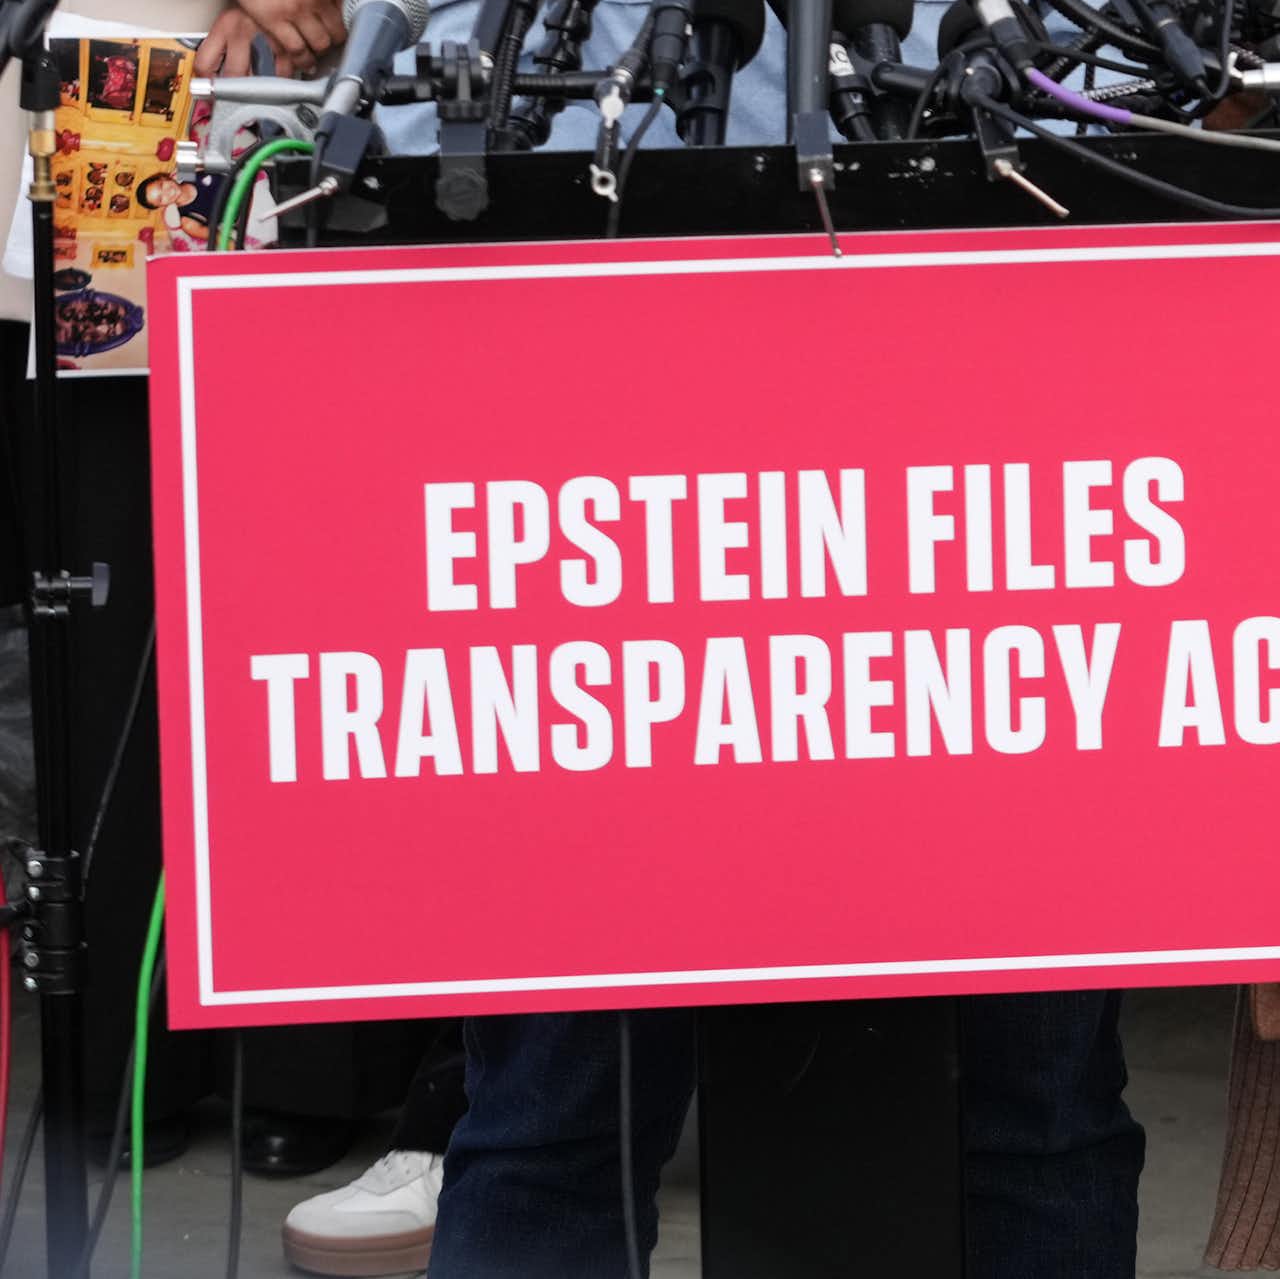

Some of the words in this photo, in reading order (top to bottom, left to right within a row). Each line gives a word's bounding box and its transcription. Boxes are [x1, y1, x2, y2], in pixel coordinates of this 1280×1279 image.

[424, 468, 868, 612] EPSTEIN
[906, 456, 1186, 594] FILES
[250, 622, 1122, 783] TRANSPARENCY
